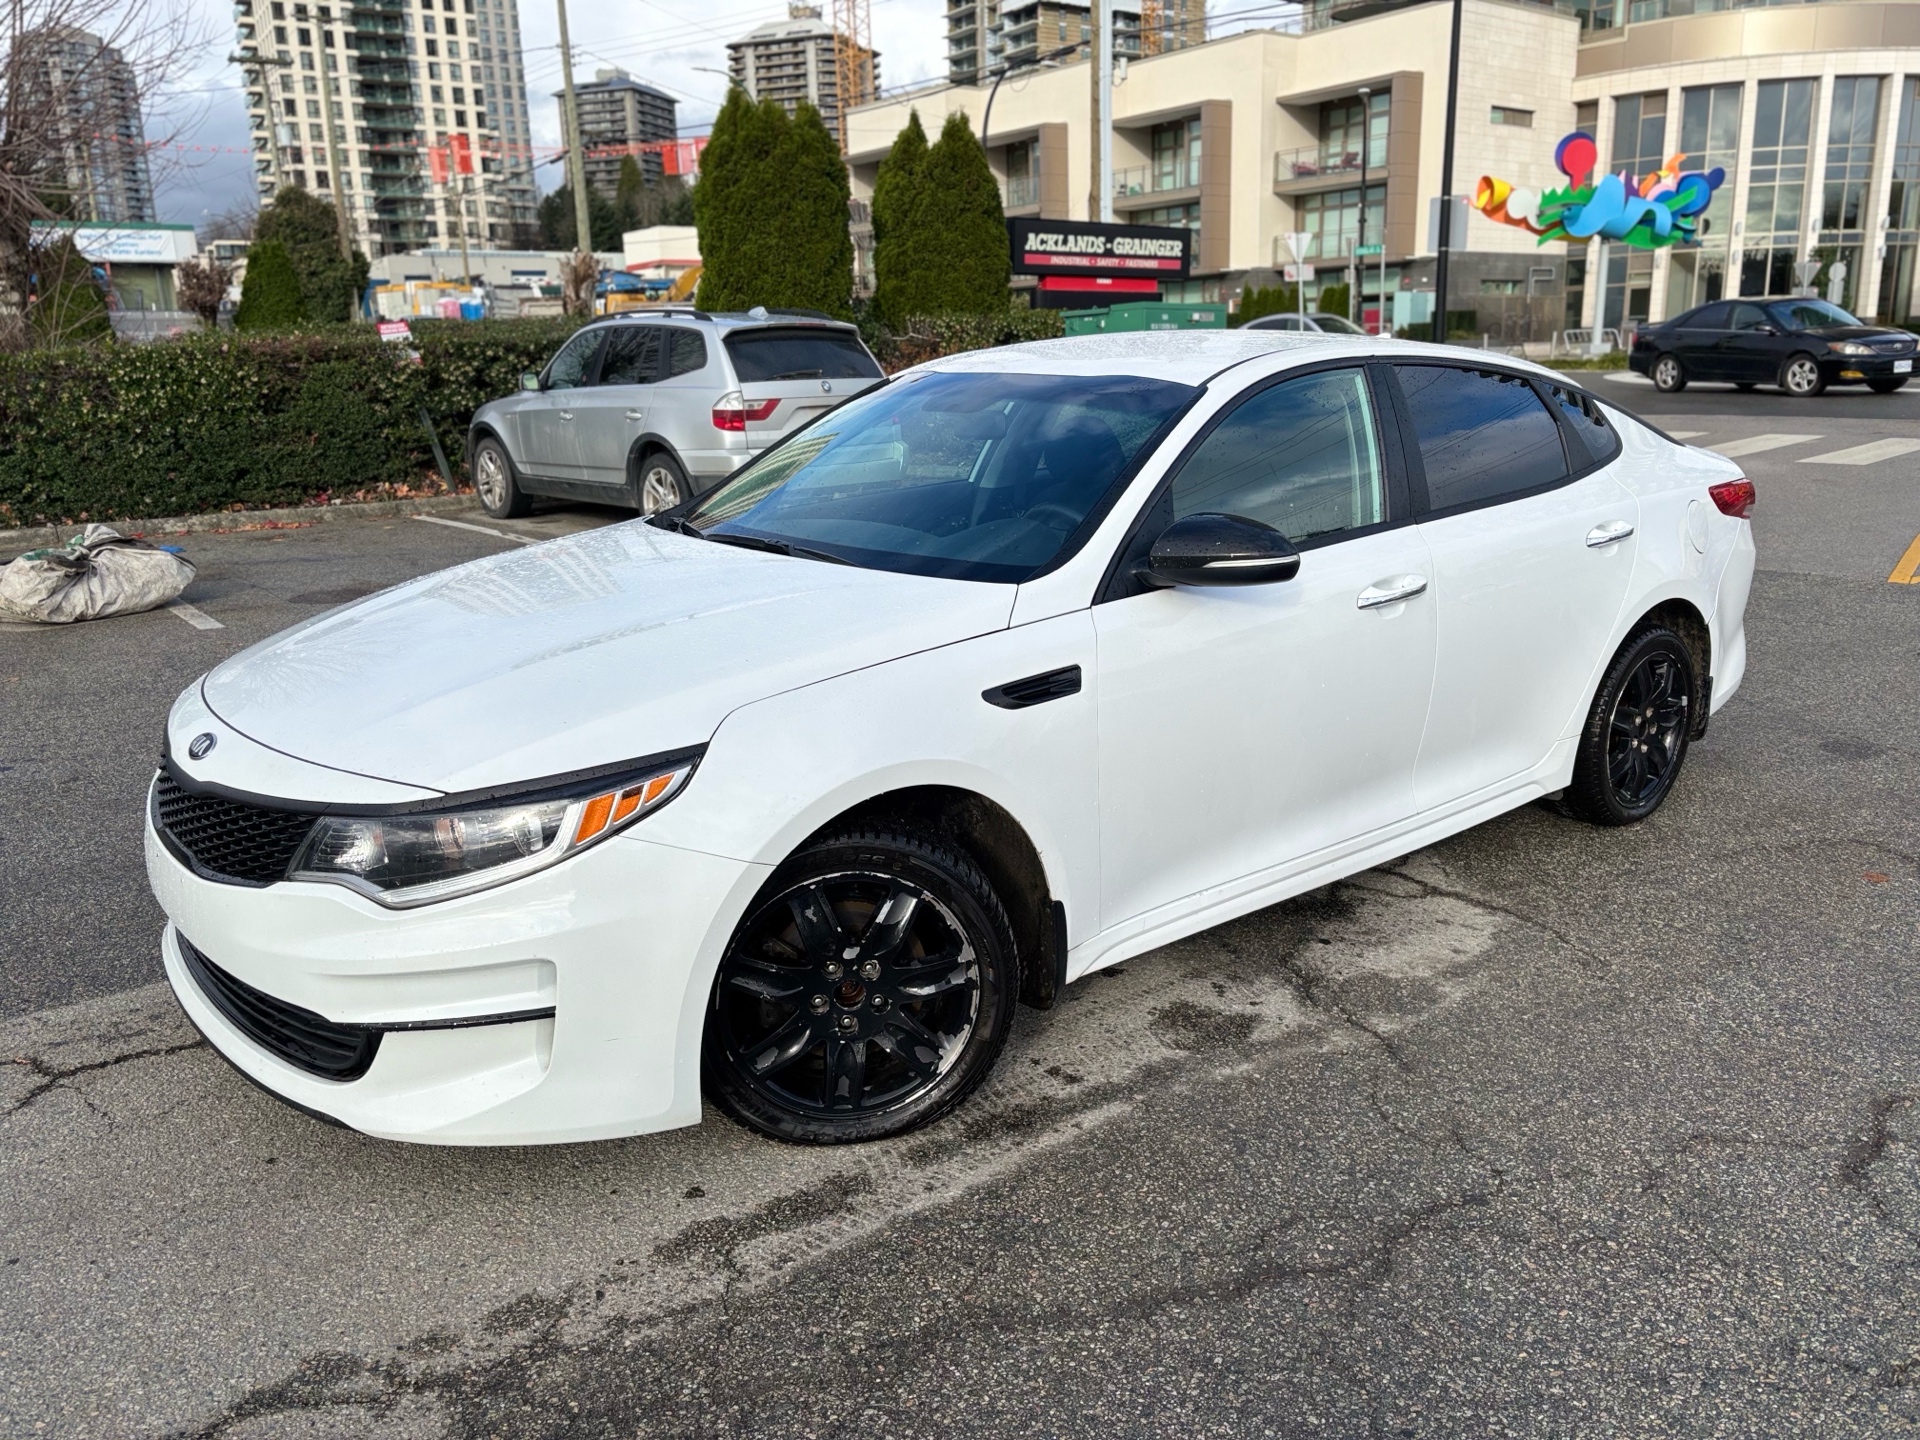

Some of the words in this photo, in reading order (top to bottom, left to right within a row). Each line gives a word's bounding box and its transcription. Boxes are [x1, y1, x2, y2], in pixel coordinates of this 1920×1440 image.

[1050, 255, 1090, 266] INDUSTRIAL
[1096, 257, 1119, 267] SAFETY
[1125, 259, 1158, 269] FASTENERS
